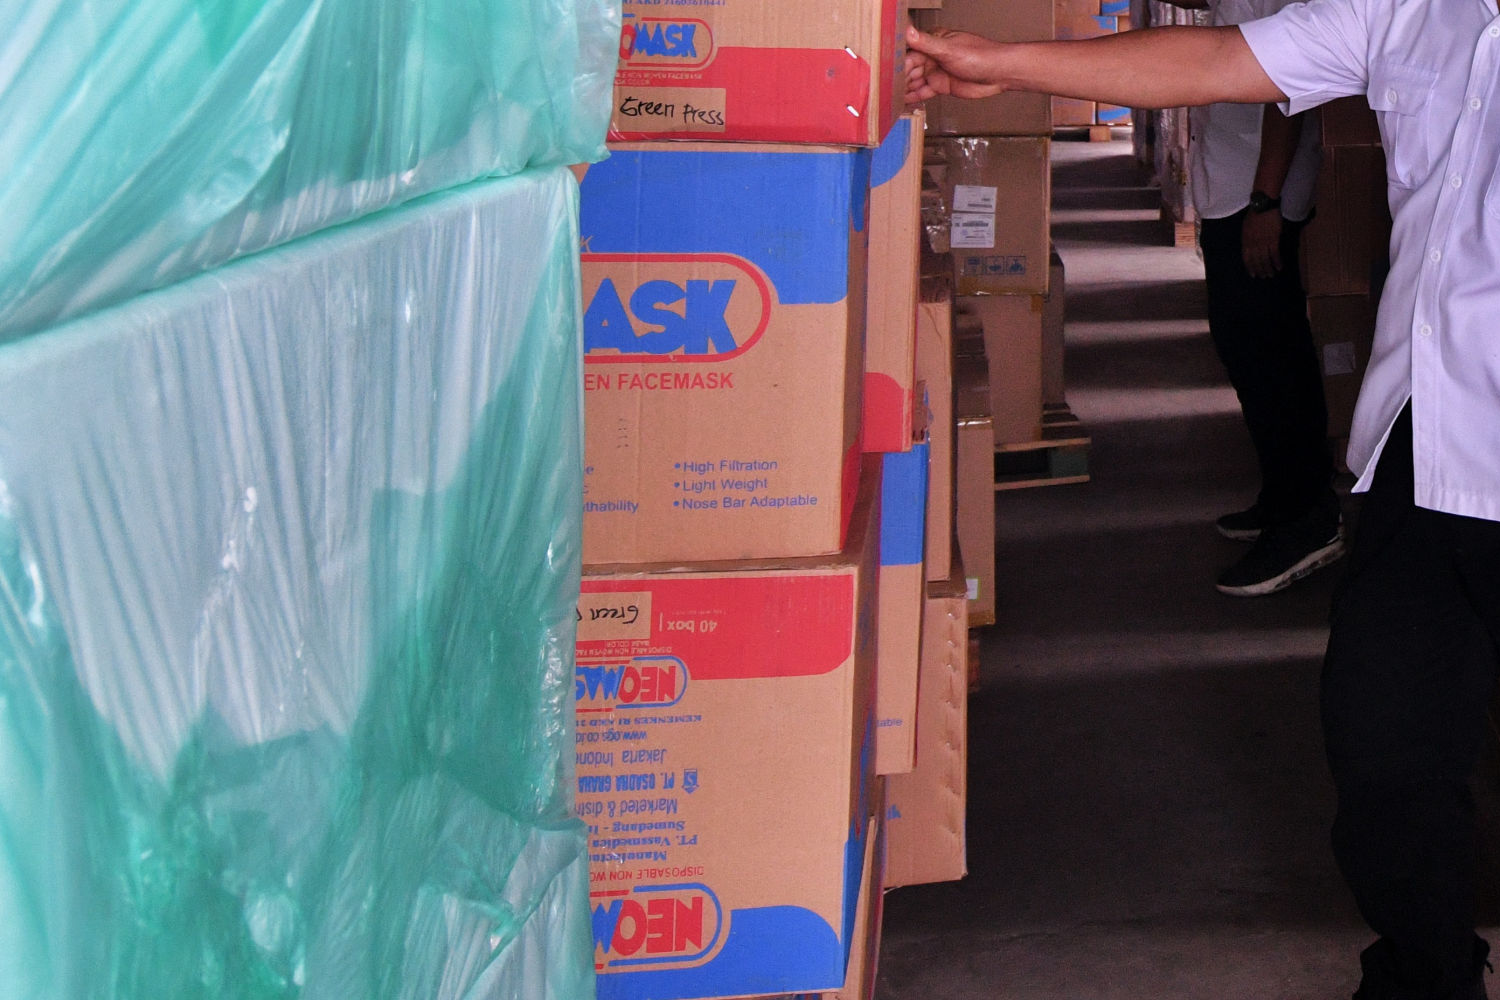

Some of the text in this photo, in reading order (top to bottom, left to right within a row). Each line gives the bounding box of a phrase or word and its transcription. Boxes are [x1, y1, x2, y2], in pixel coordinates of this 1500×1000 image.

[619, 22, 697, 61] OMASK
[620, 96, 725, 126] Green Press
[583, 277, 739, 355] ASK
[584, 372, 735, 391] EN FACEMASK
[682, 459, 779, 476] High Filtration
[682, 477, 768, 495] Light Weight
[585, 500, 639, 515] thability
[682, 494, 818, 511] Nose Bar Adaptable
[666, 619, 718, 633] 40 box
[576, 665, 677, 704] NEOMAS
[621, 748, 667, 765] Jakarta
[607, 800, 617, 818] &
[620, 798, 678, 815] Marketed
[612, 820, 686, 833] Sumedang
[610, 871, 633, 882] NON
[637, 865, 704, 881] DISPOSABLE
[592, 896, 703, 957] NEOM
